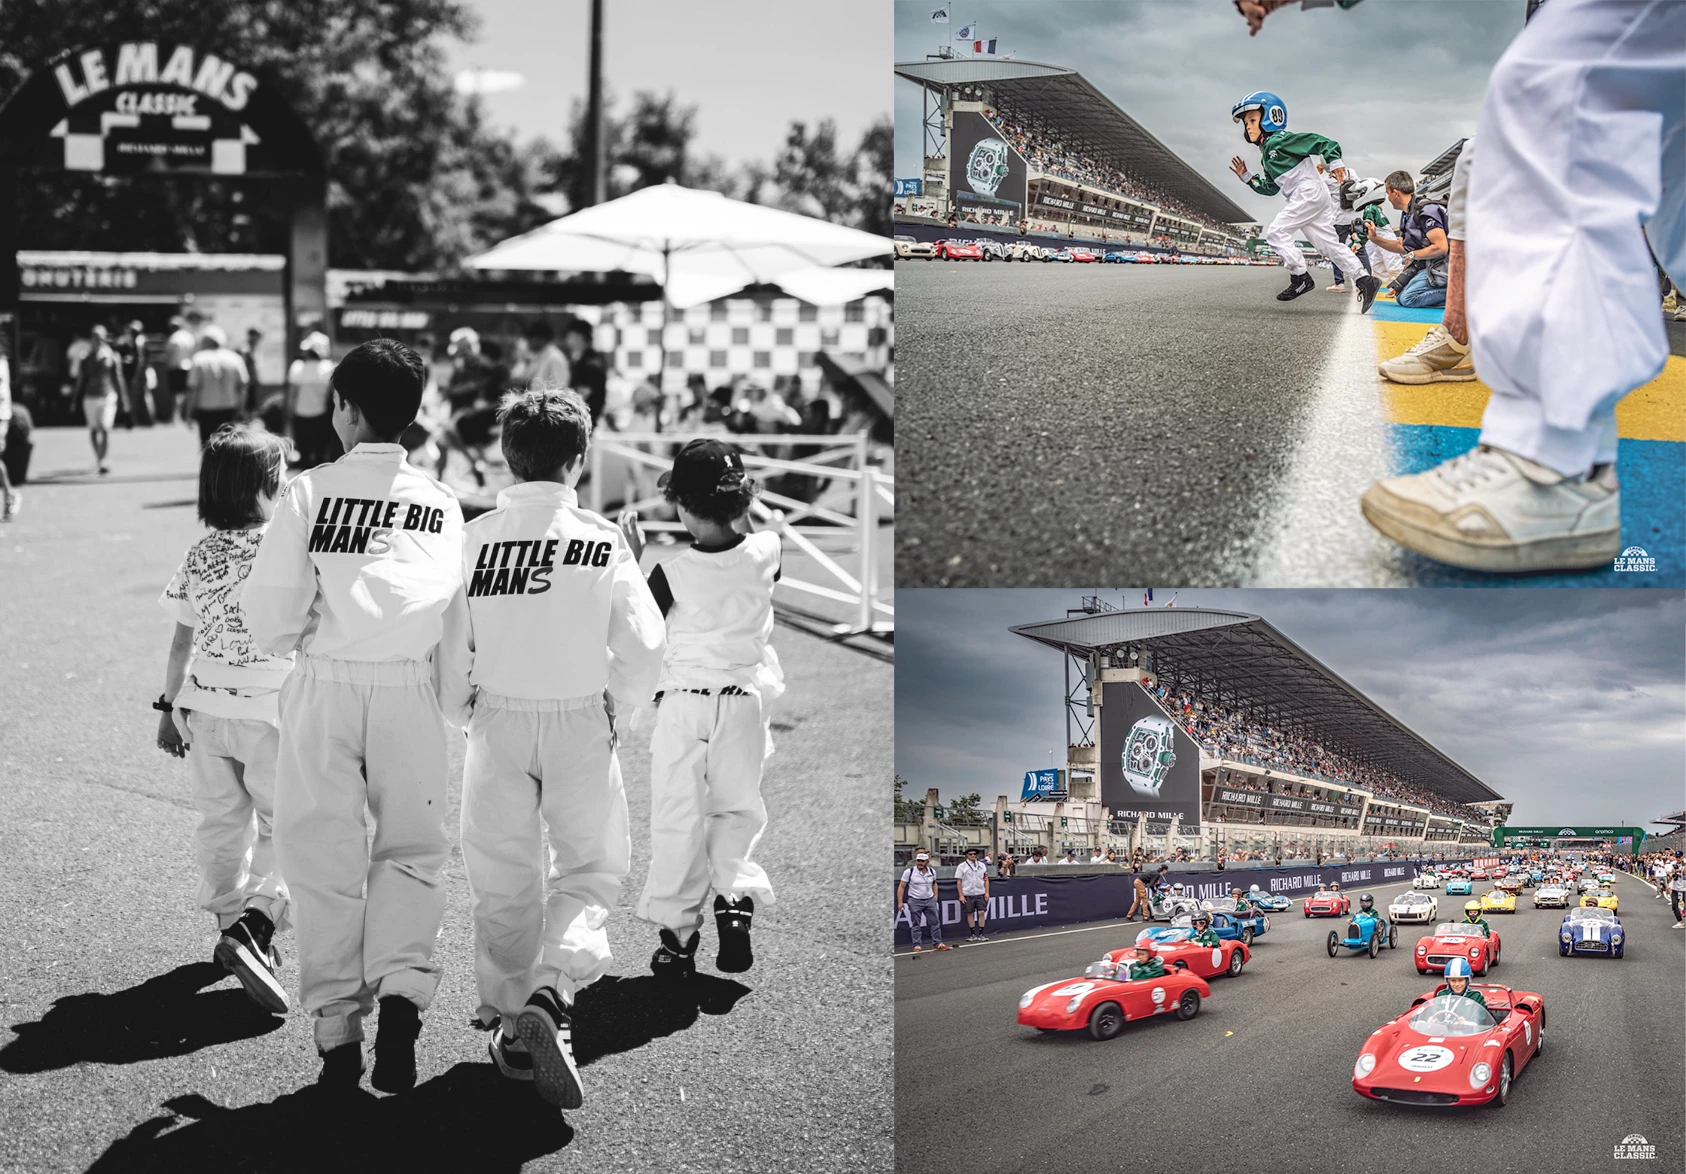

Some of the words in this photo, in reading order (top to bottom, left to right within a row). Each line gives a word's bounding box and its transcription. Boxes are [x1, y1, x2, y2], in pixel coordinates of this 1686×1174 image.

[55, 49, 110, 106] LE
[114, 42, 258, 111] MANS
[1271, 108, 1284, 123] 89
[315, 497, 400, 528] LITTLE
[403, 503, 444, 534] BIG
[308, 525, 394, 554] MANS
[475, 539, 559, 569] LITTLE
[562, 539, 613, 567] BIG
[467, 566, 554, 597] MANS
[1221, 791, 1246, 803] RICHARD
[1246, 795, 1262, 804] MILLE
[1199, 882, 1231, 900] MILLE
[1270, 875, 1302, 892] RICHARD
[1303, 874, 1321, 888] MILLE
[1410, 1053, 1442, 1063] 22
